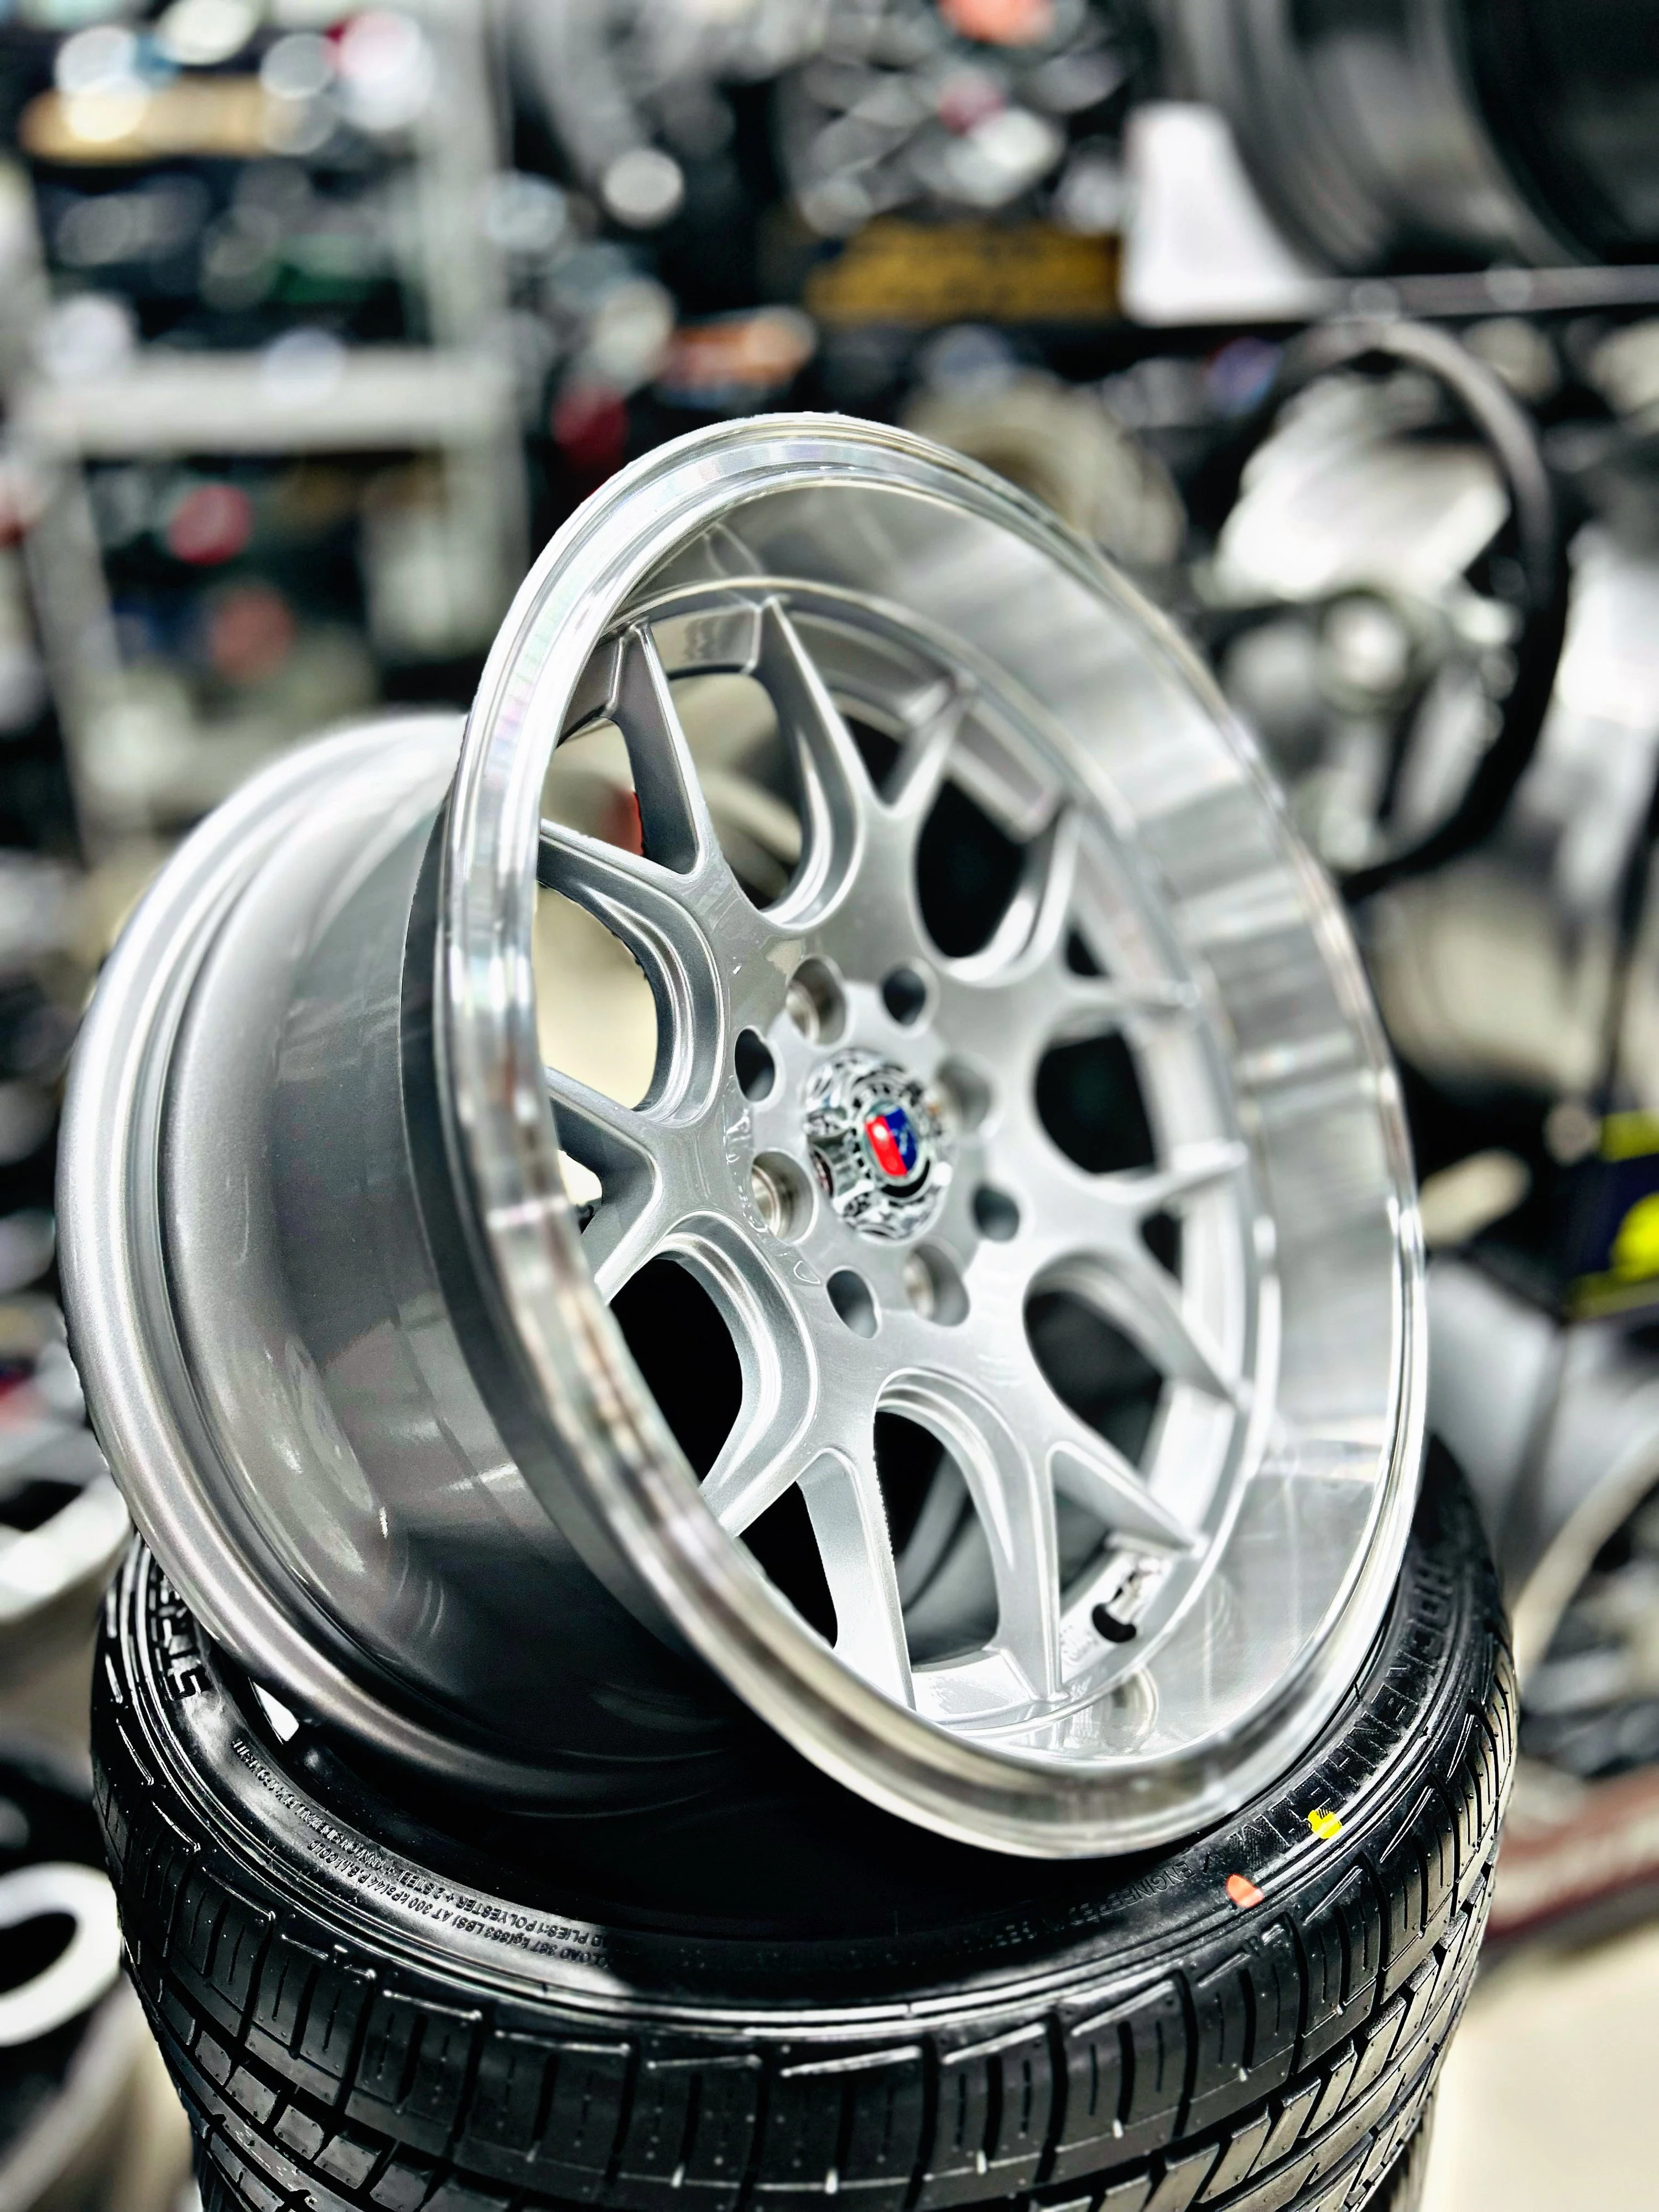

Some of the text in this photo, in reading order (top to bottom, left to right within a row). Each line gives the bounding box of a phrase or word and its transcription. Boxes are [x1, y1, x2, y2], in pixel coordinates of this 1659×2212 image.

[307, 1840, 339, 1864] COLD
[398, 1871, 435, 1895] STEEL
[434, 1887, 446, 1901] 2
[446, 1892, 455, 1903] +
[1069, 1861, 1195, 1925] ENGINEERED
[409, 1896, 433, 1915] 300
[431, 1908, 454, 1922] AT
[455, 1896, 538, 1932] POLYESTER
[452, 1914, 484, 1933] LBS)
[559, 1947, 600, 1966] LOAD
